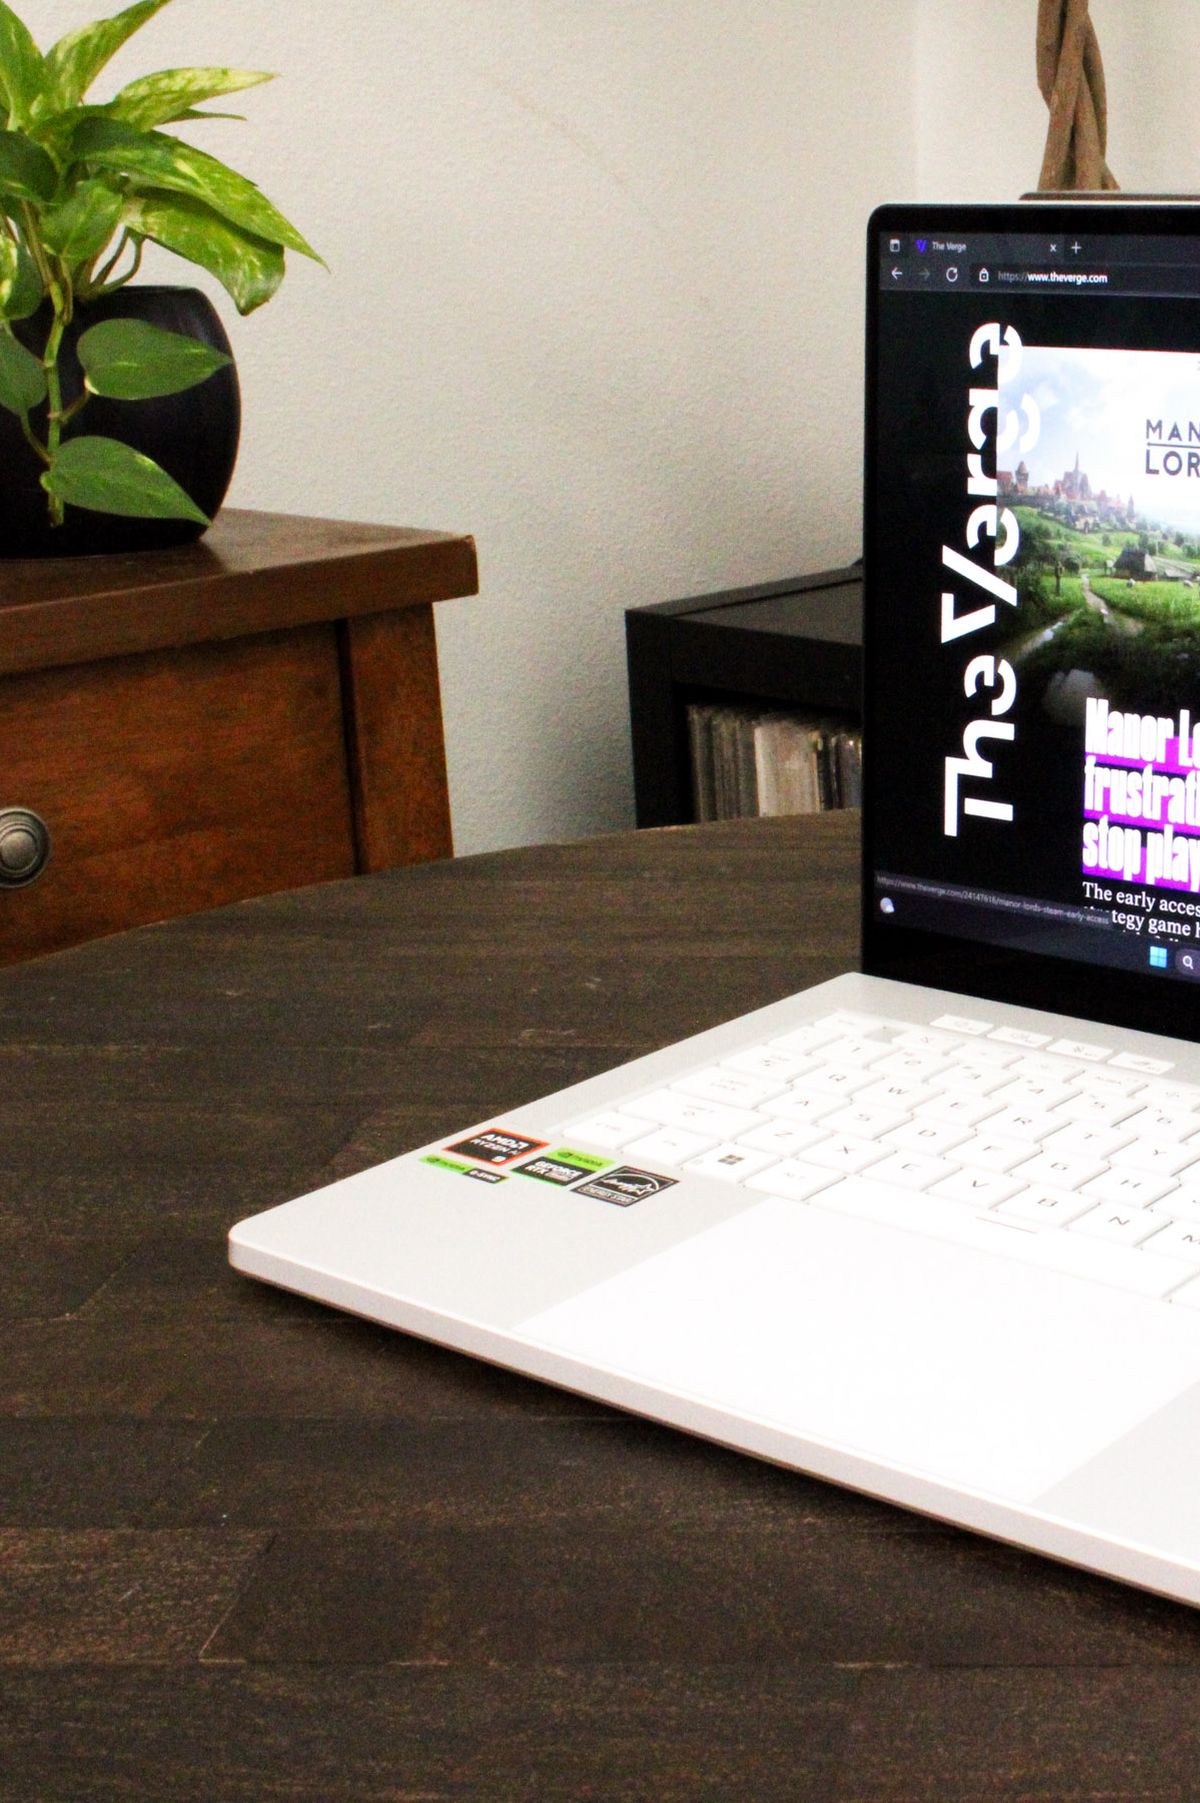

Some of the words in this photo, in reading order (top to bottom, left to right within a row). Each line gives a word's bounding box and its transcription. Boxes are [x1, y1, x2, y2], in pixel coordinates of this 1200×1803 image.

[932, 241, 946, 251] The
[946, 241, 967, 253] Verge
[998, 271, 1108, 285] https://www.theverge.com
[941, 322, 1041, 643] Verge
[944, 654, 1017, 837] The
[1085, 697, 1175, 763] Manor
[1083, 814, 1142, 882] stop
[1082, 881, 1112, 901] The
[1115, 887, 1155, 911] early
[1148, 916, 1191, 936] game
